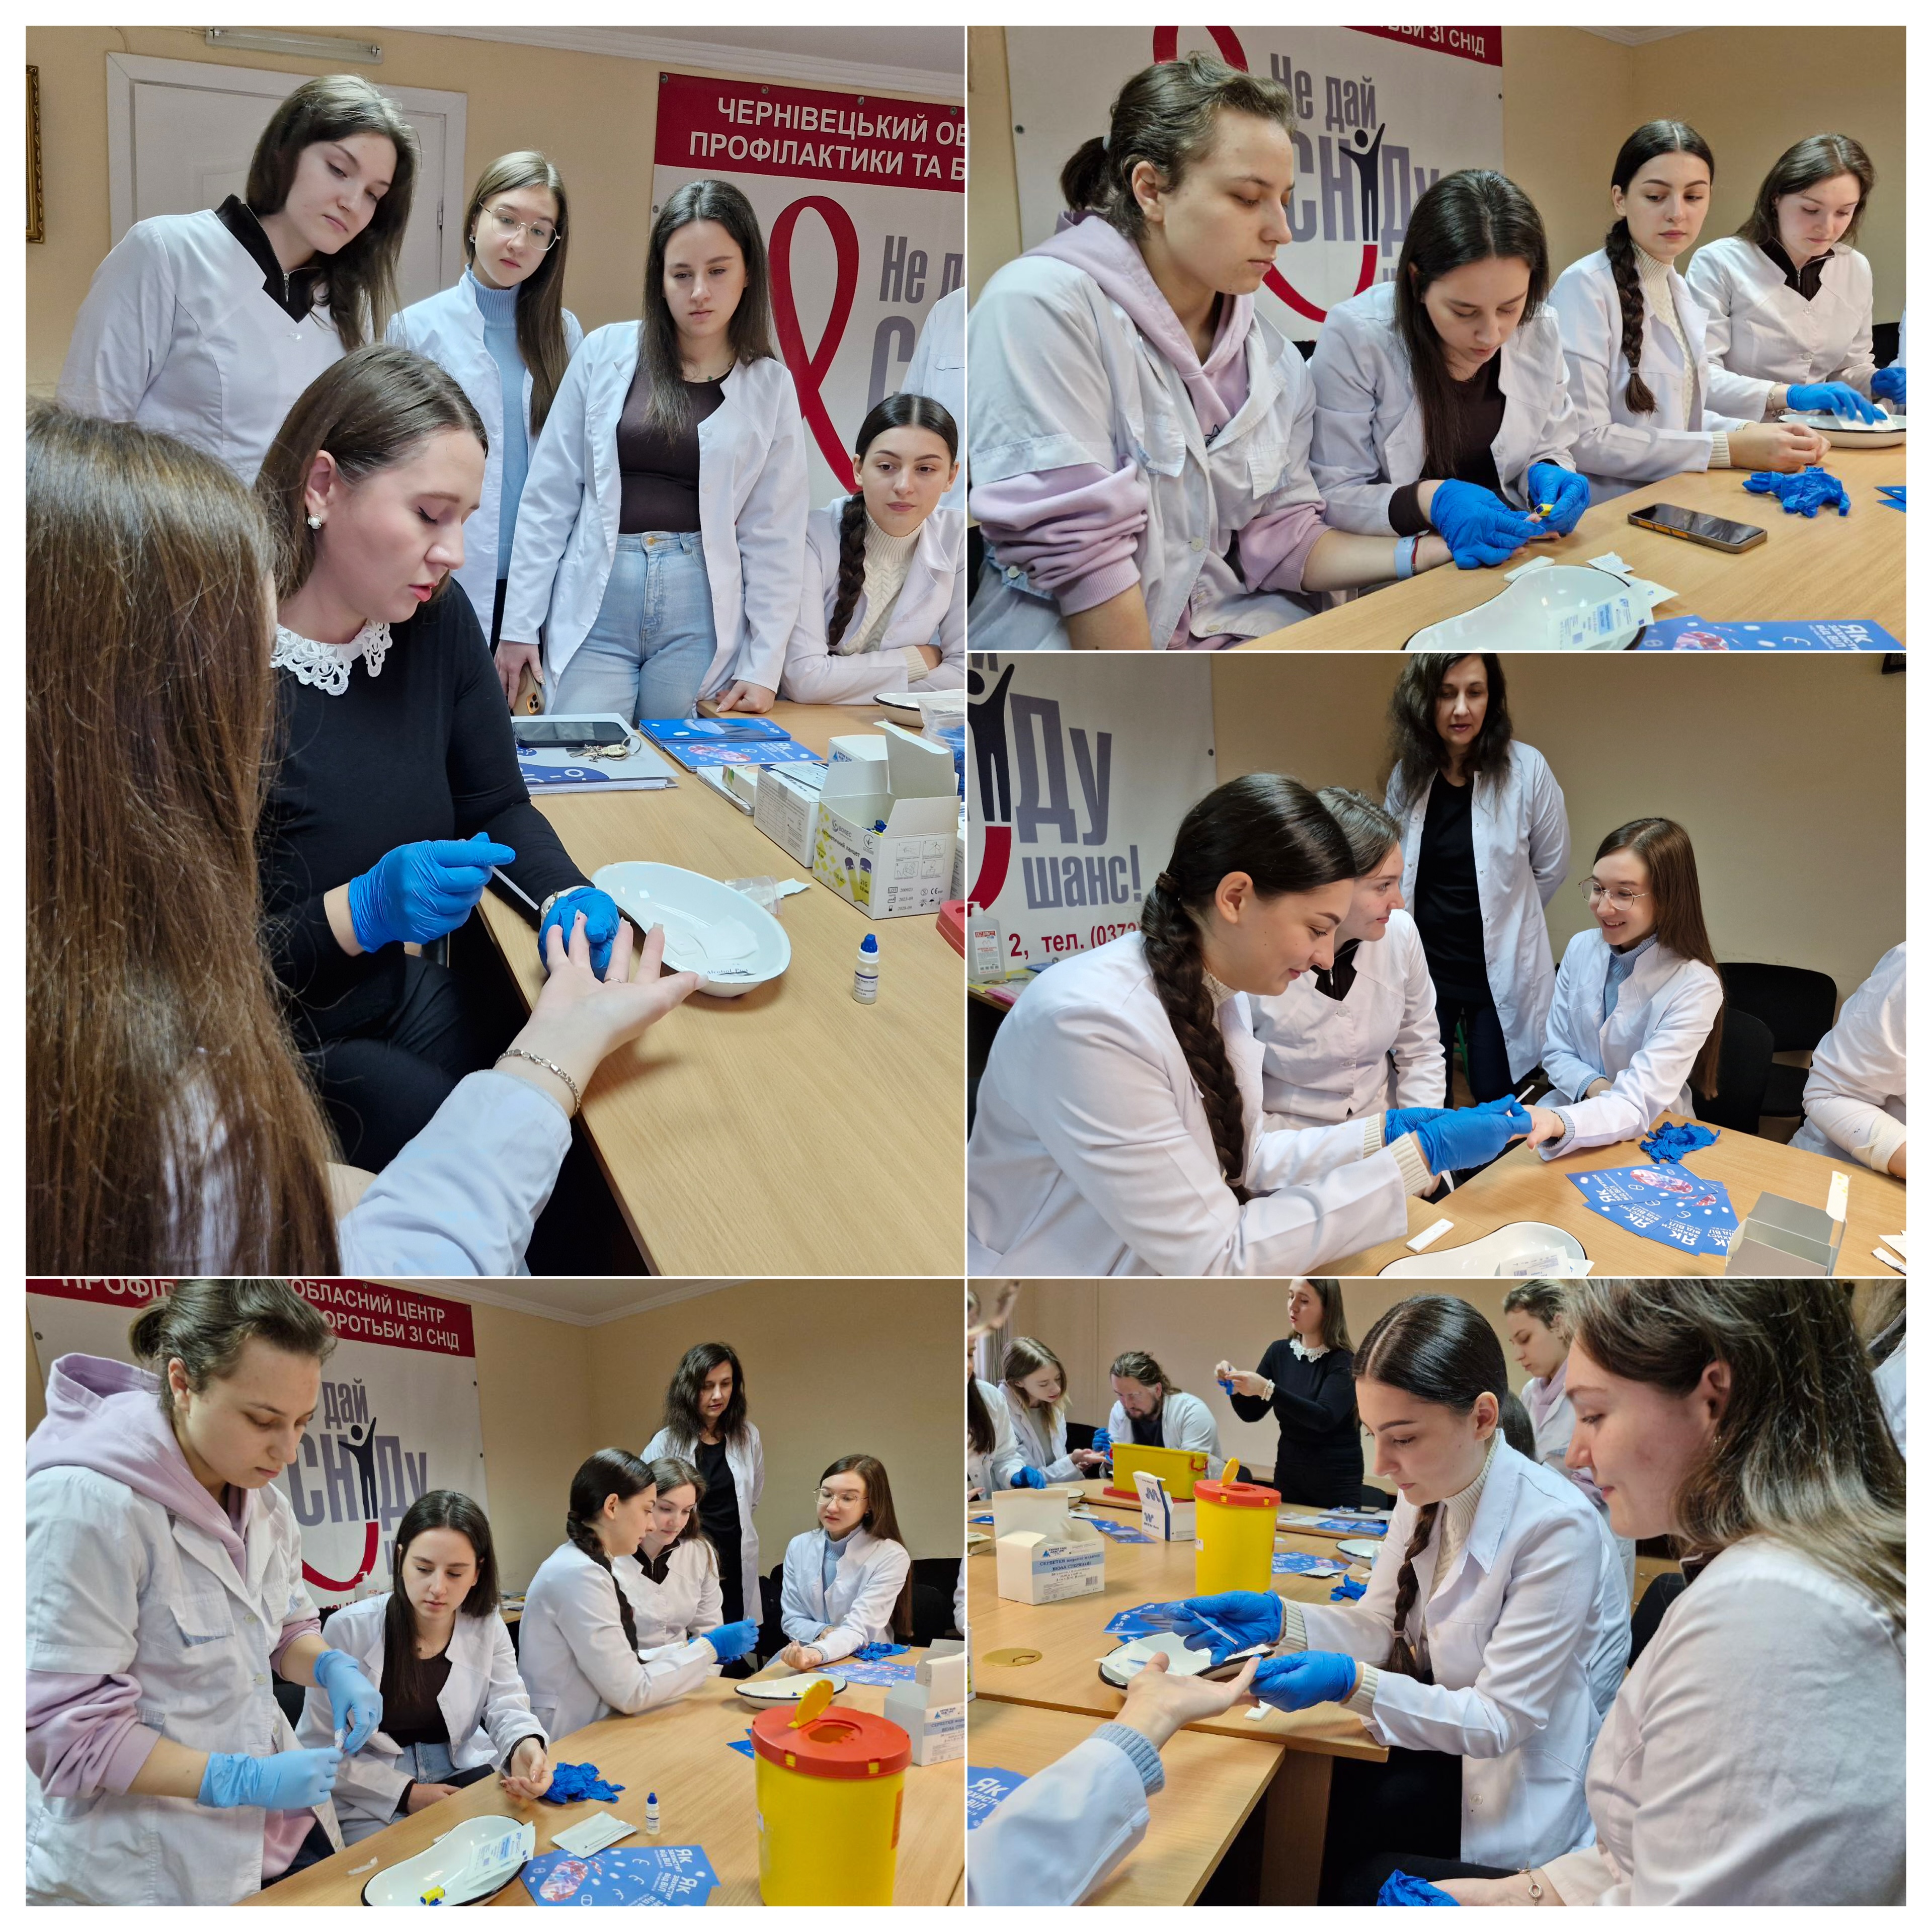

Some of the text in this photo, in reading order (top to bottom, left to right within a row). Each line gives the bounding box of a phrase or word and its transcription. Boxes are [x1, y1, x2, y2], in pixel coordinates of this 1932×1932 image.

[1449, 30, 1485, 58] СНІД
[718, 97, 927, 143] ЧЕРНІВЕЦЬКИЙ
[1325, 76, 1377, 133] дай
[689, 131, 903, 175] ПРОФІЛАКТИКИ
[913, 154, 942, 179] ТА
[879, 235, 928, 304] Не
[860, 879, 868, 888] 21G
[1022, 845, 1142, 910] шанс!
[1009, 933, 1028, 960] 2,
[1041, 933, 1084, 953] тел.
[1668, 1221, 1684, 1229] ВІЛ
[1668, 1230, 1697, 1246] Як
[291, 1279, 392, 1315] ОБЛАСНИЙ
[396, 1300, 445, 1323] ЦЕНТР
[324, 1310, 460, 1352] ОРОТЬБИ ЗІ СНІД
[321, 1378, 369, 1430] дай
